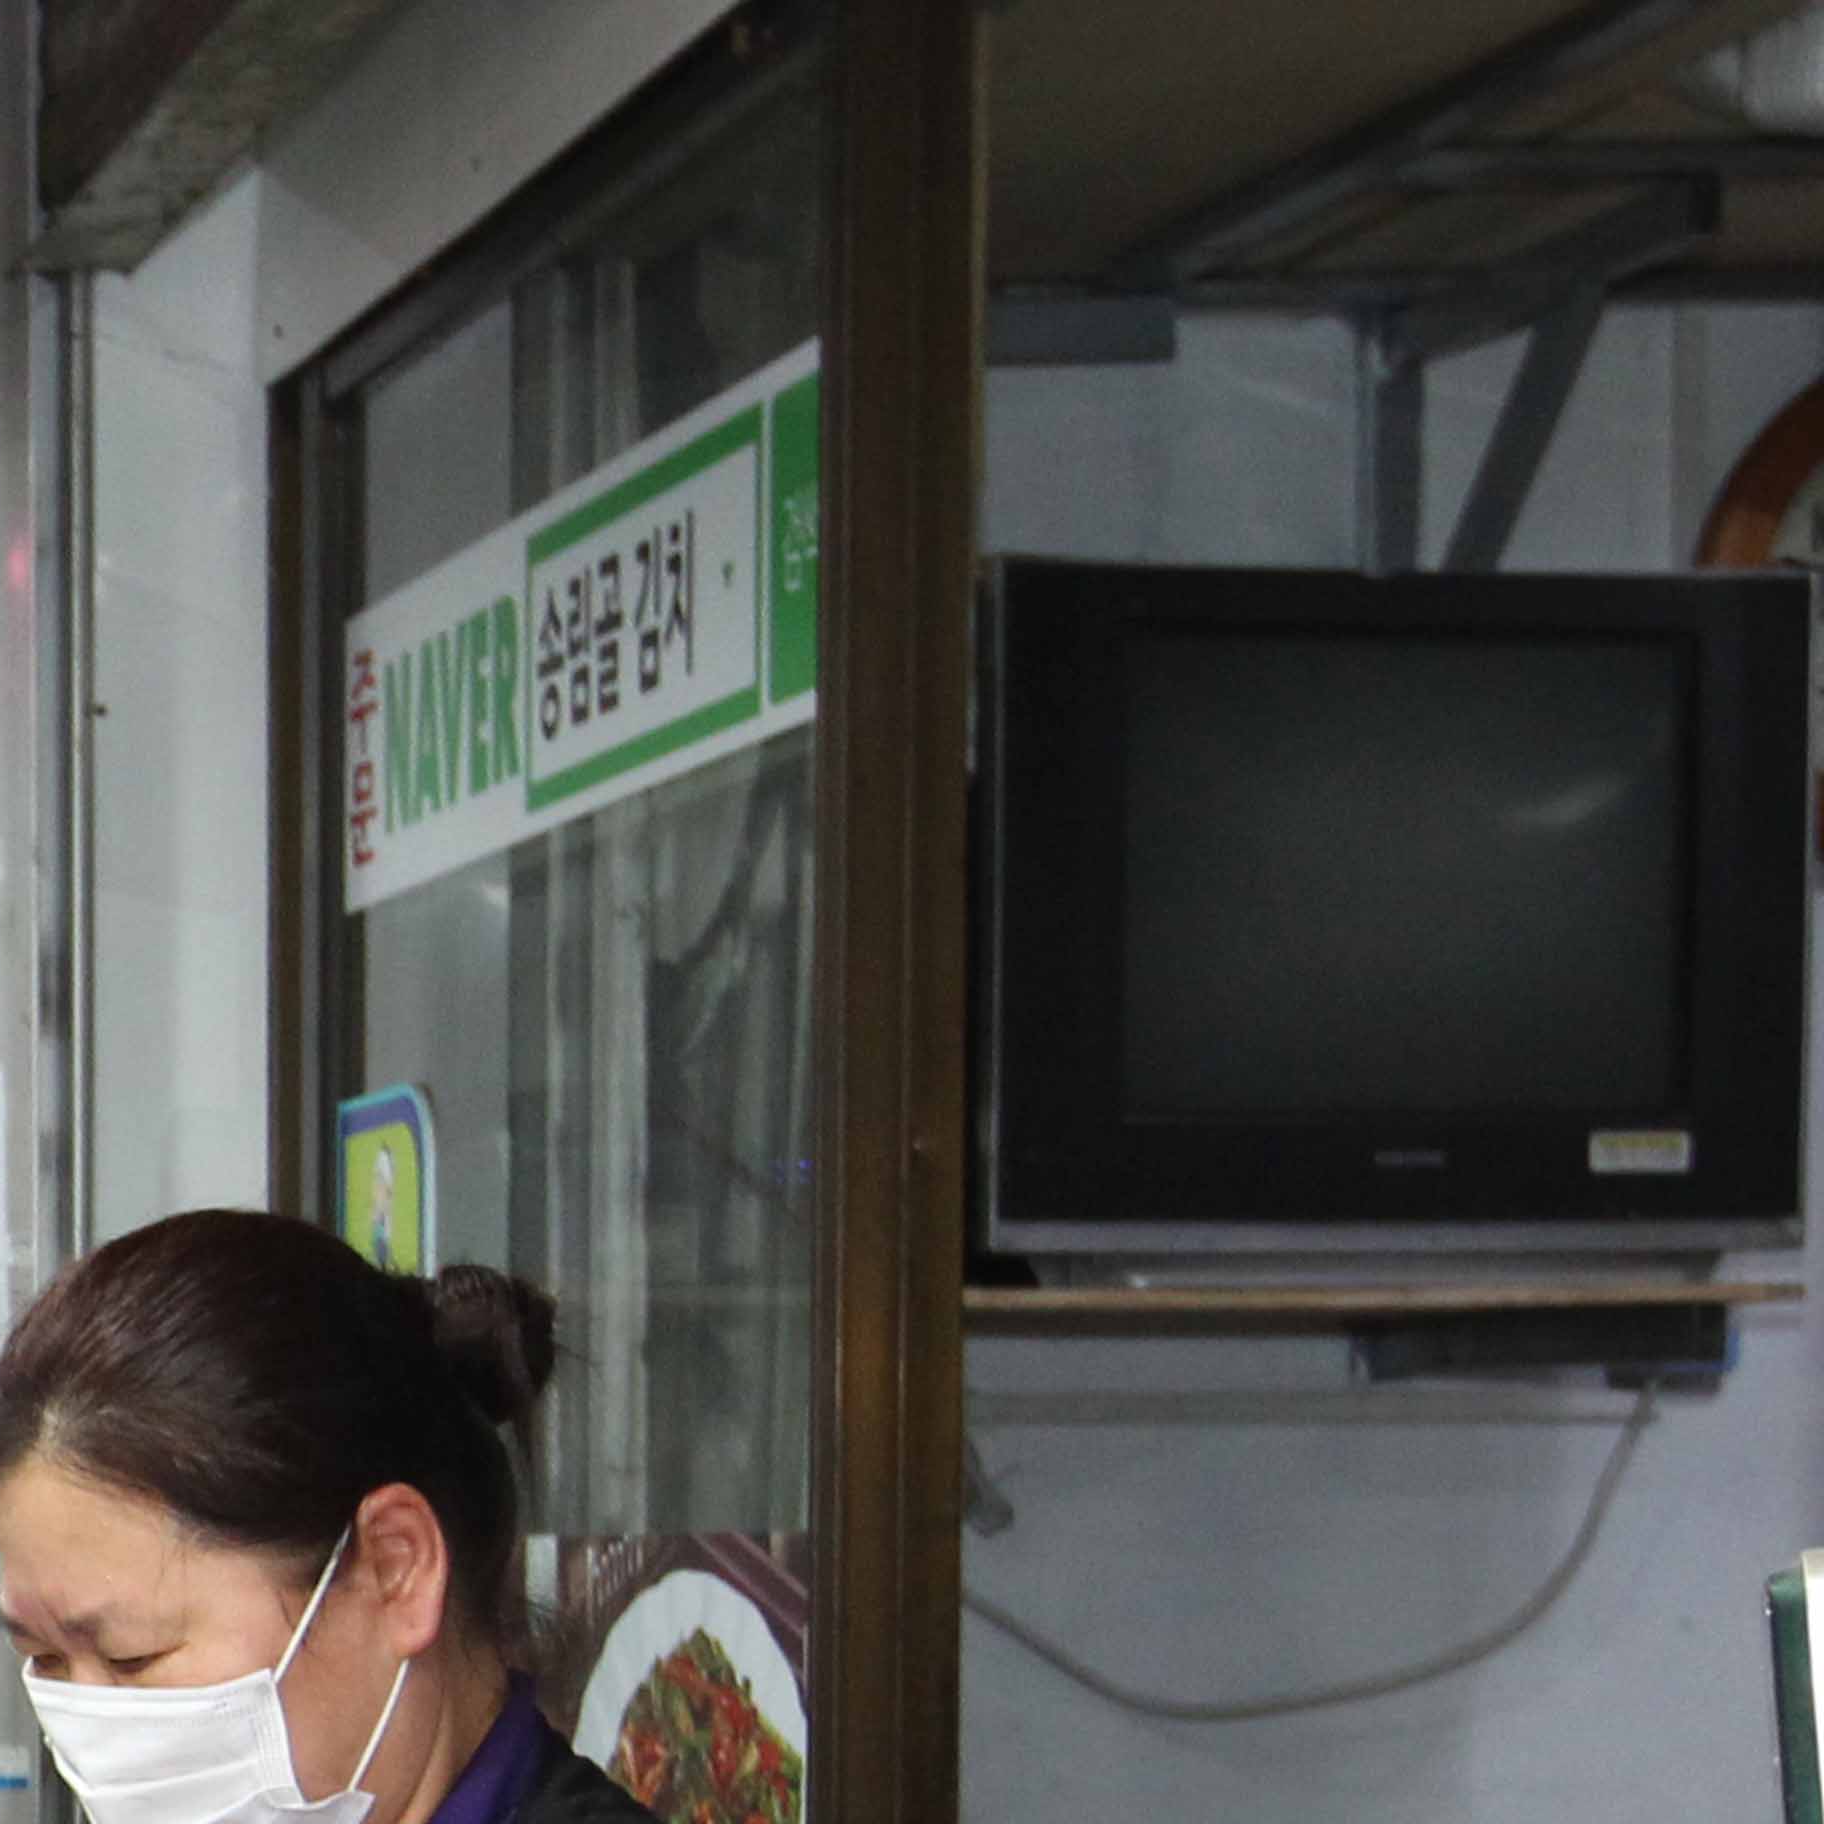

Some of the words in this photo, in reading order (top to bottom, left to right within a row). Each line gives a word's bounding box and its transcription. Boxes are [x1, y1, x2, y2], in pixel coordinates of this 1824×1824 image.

[383, 594, 521, 835] NAVER
[537, 550, 624, 742] 송림골
[634, 508, 695, 695] 김치
